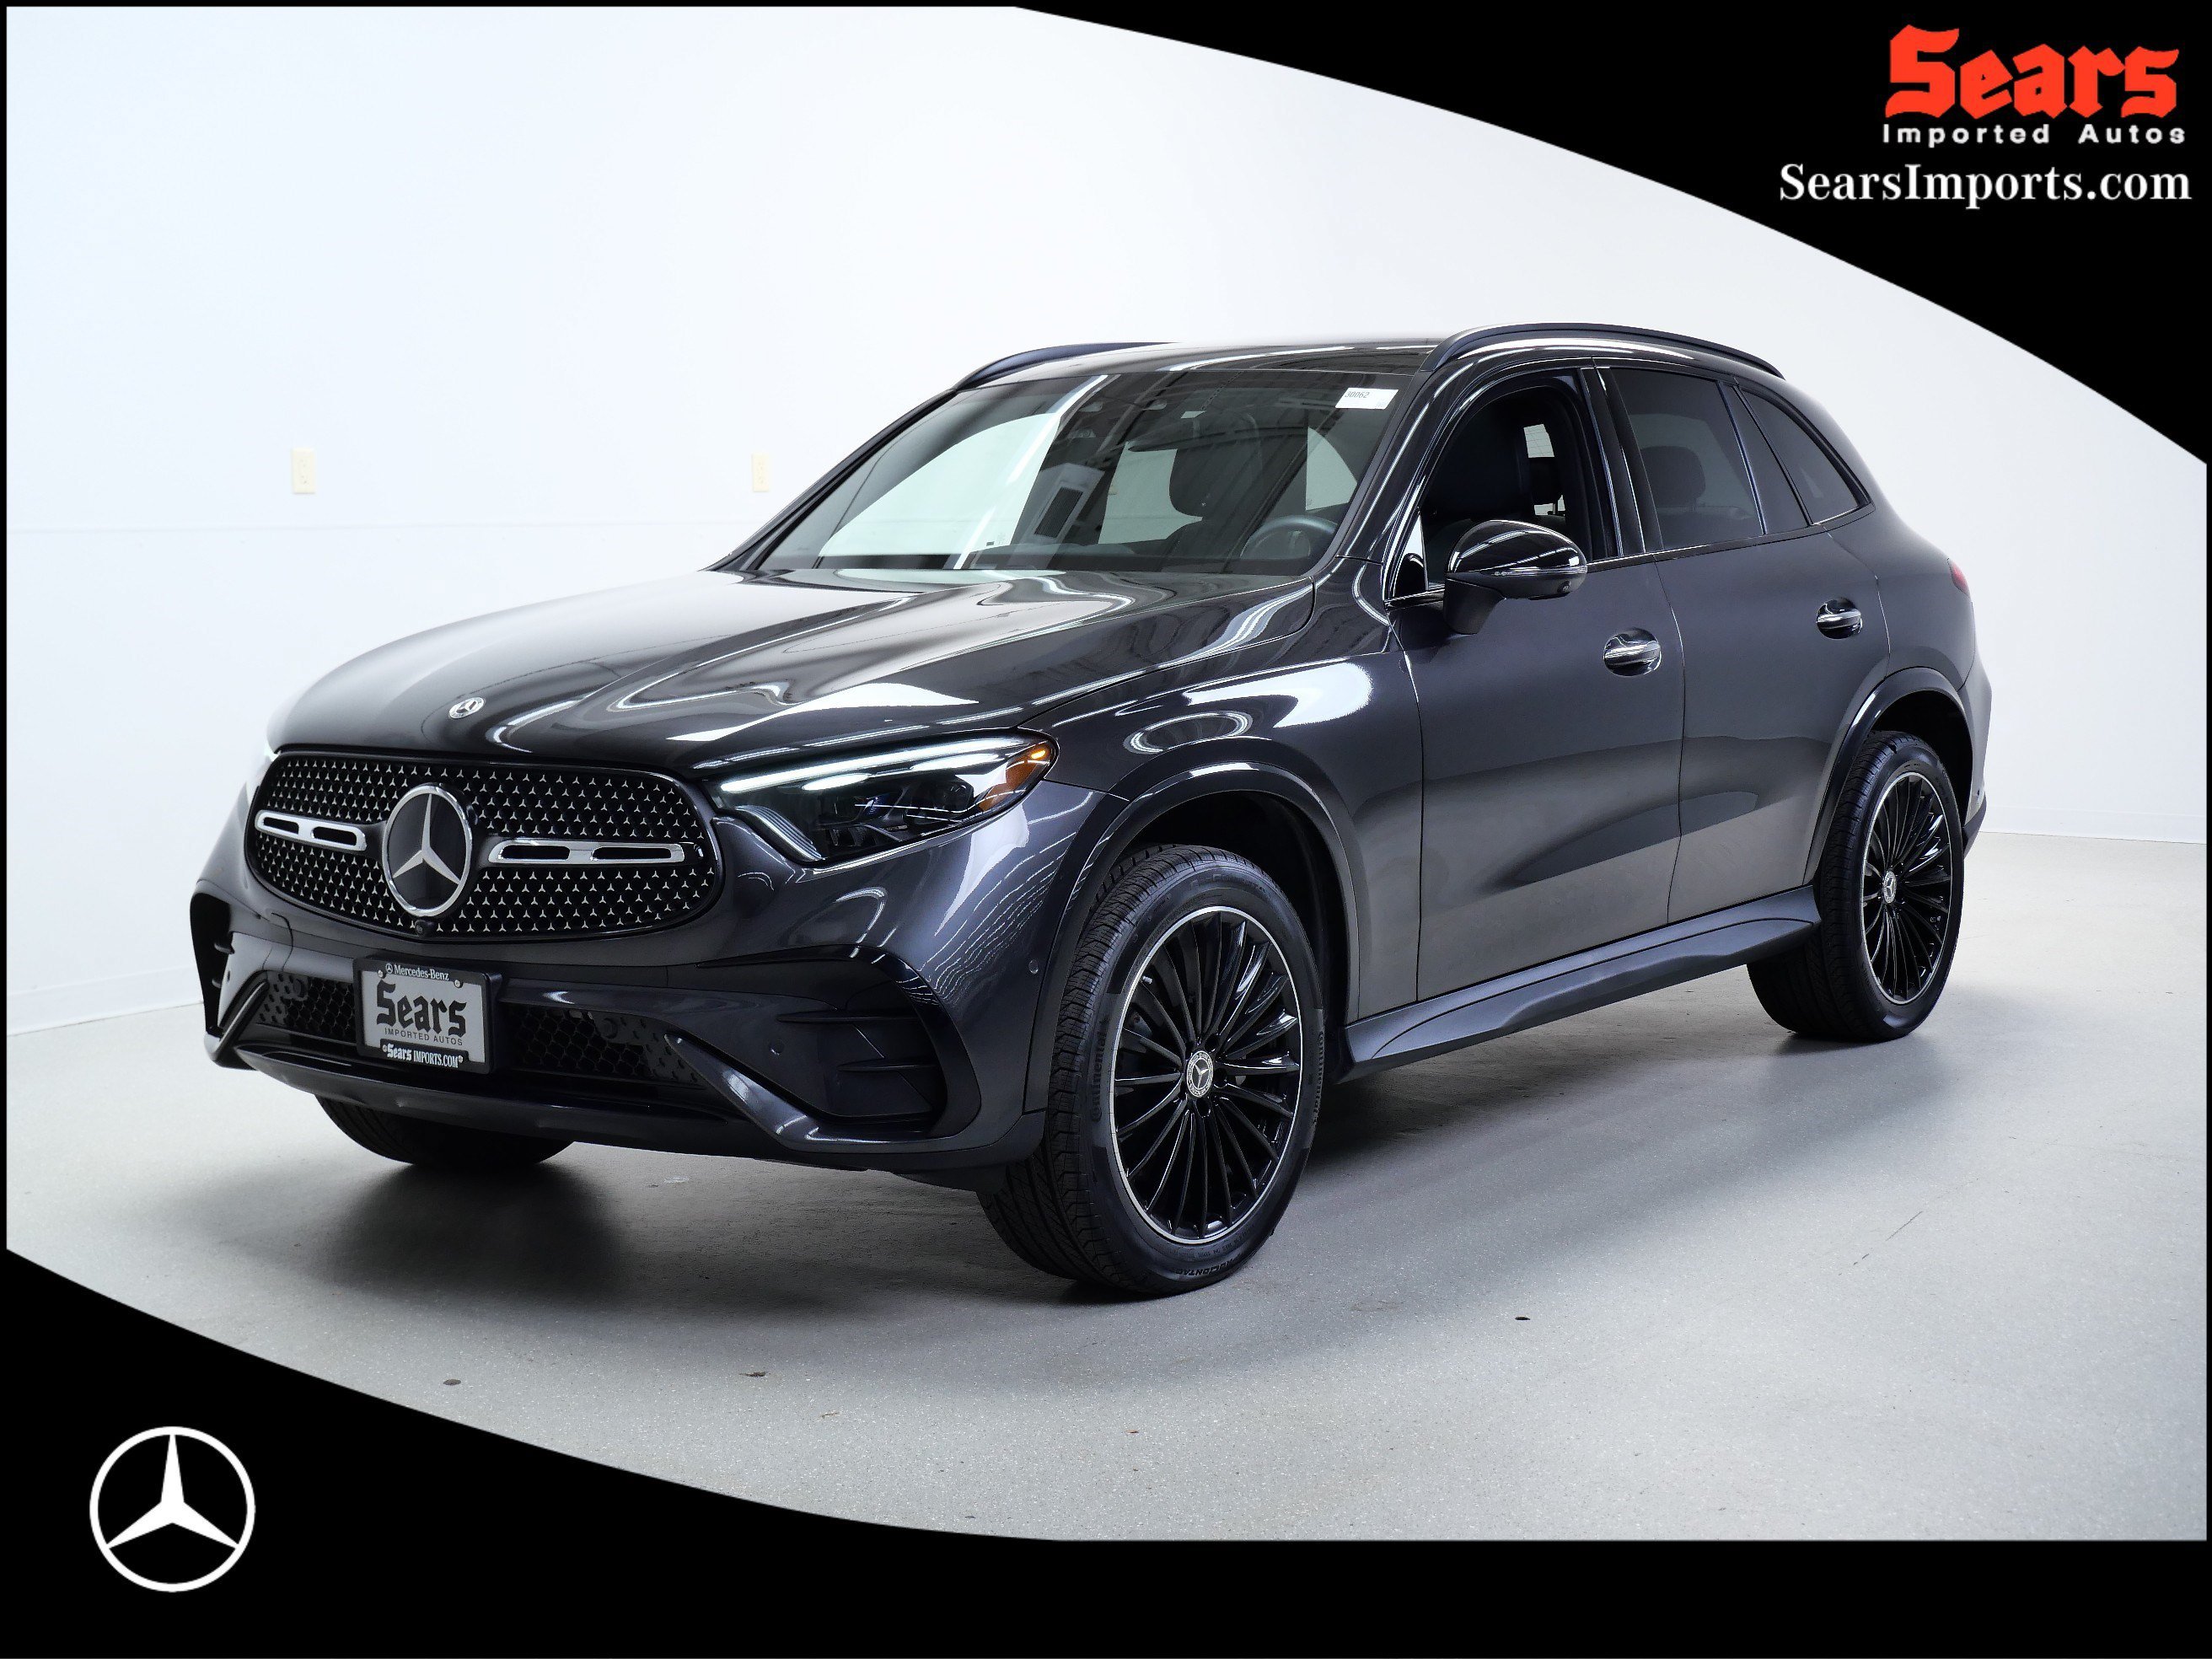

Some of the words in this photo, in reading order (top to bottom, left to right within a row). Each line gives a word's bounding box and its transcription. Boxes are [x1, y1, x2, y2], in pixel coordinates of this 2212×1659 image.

[394, 964, 449, 980] Mercedes-Benz
[377, 980, 467, 1038] Sears
[384, 1028, 430, 1041] IMPORTED
[433, 1036, 463, 1046] AUTOS
[387, 1043, 412, 1061] Sears
[413, 1050, 459, 1068] IMPORTS.COM
